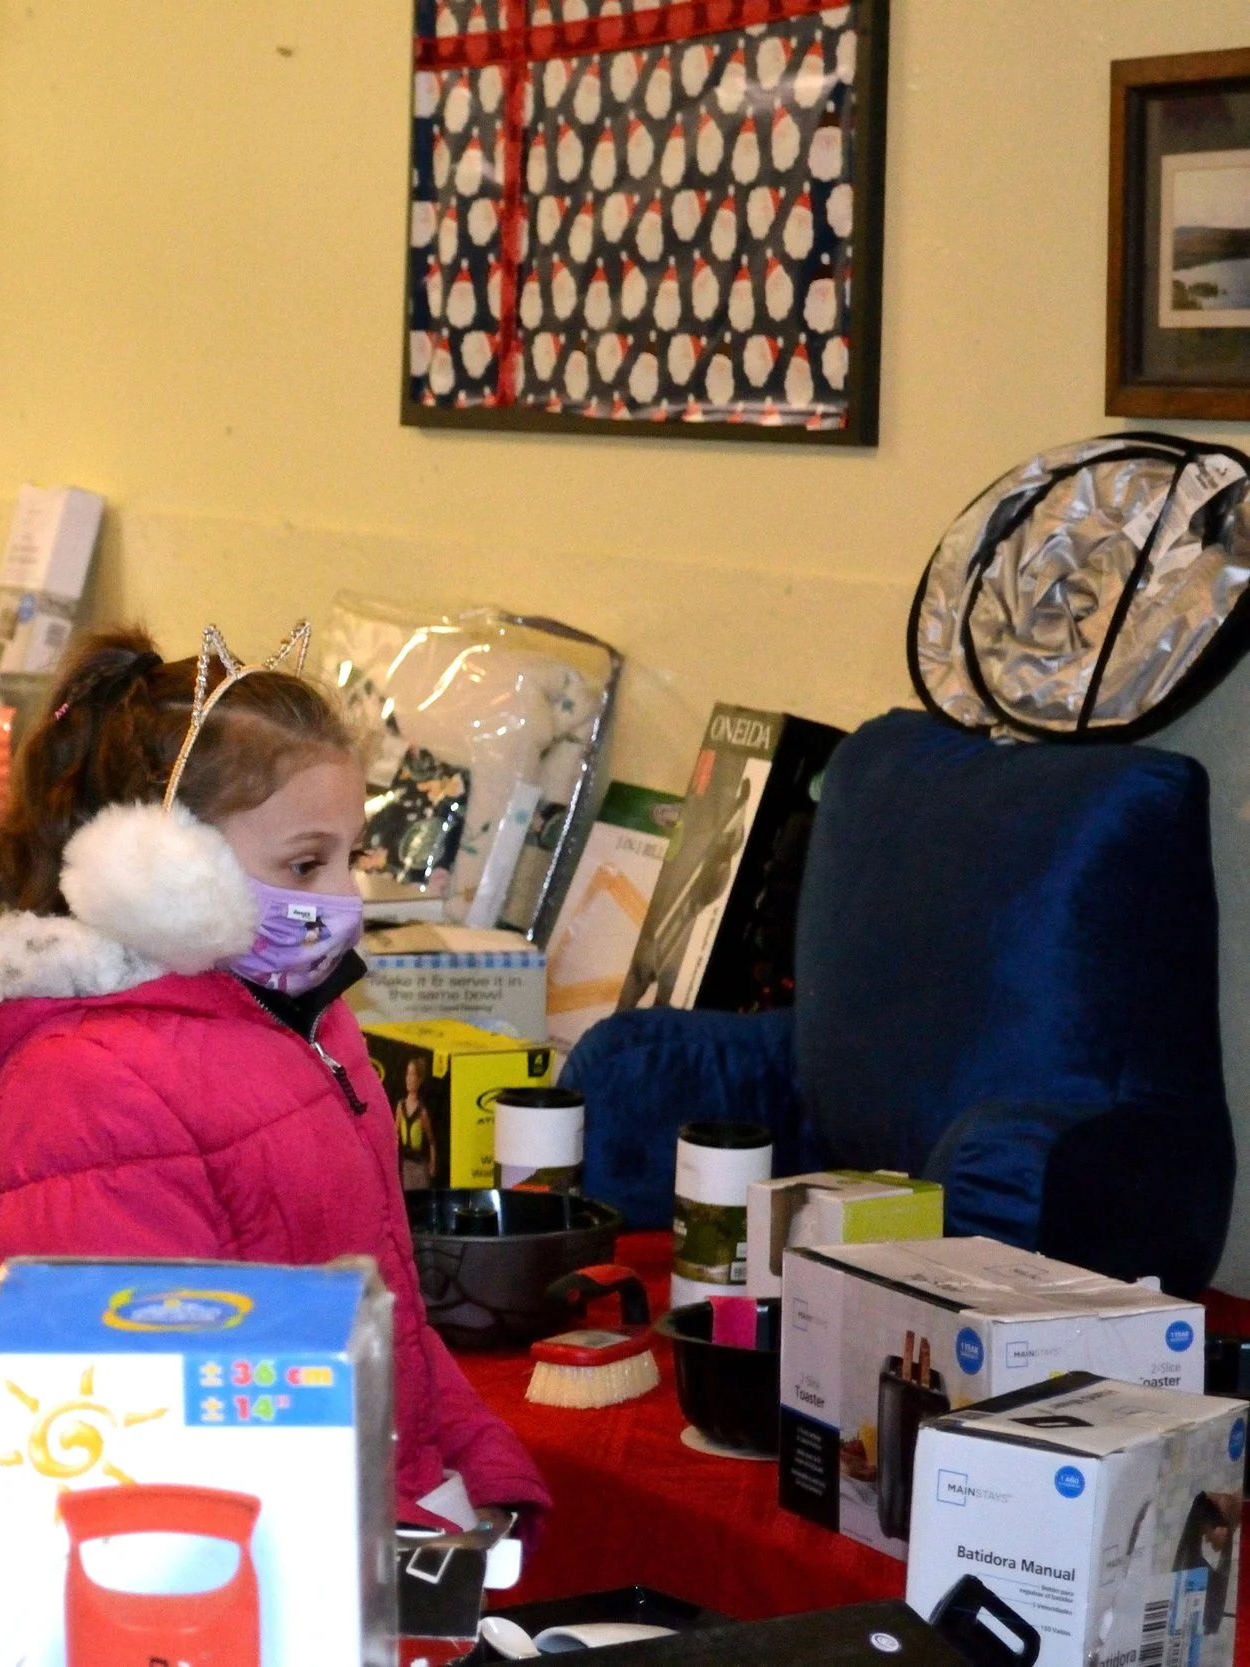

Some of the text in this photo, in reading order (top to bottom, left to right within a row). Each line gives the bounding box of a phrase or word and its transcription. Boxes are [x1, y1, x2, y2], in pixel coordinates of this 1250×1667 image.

[711, 714, 772, 750] ONEIDA
[450, 976, 489, 987] serve
[494, 975, 503, 986] it
[389, 989, 503, 1001] the same bowl
[231, 1358, 277, 1387] 36
[285, 1366, 334, 1387] cm
[1151, 1361, 1181, 1374] 2-Slice
[1140, 1375, 1181, 1387] oaster
[794, 1384, 825, 1409] Toaster
[948, 1483, 1009, 1505] MAINSTAYS
[957, 1545, 1076, 1583] Batidora Manual
